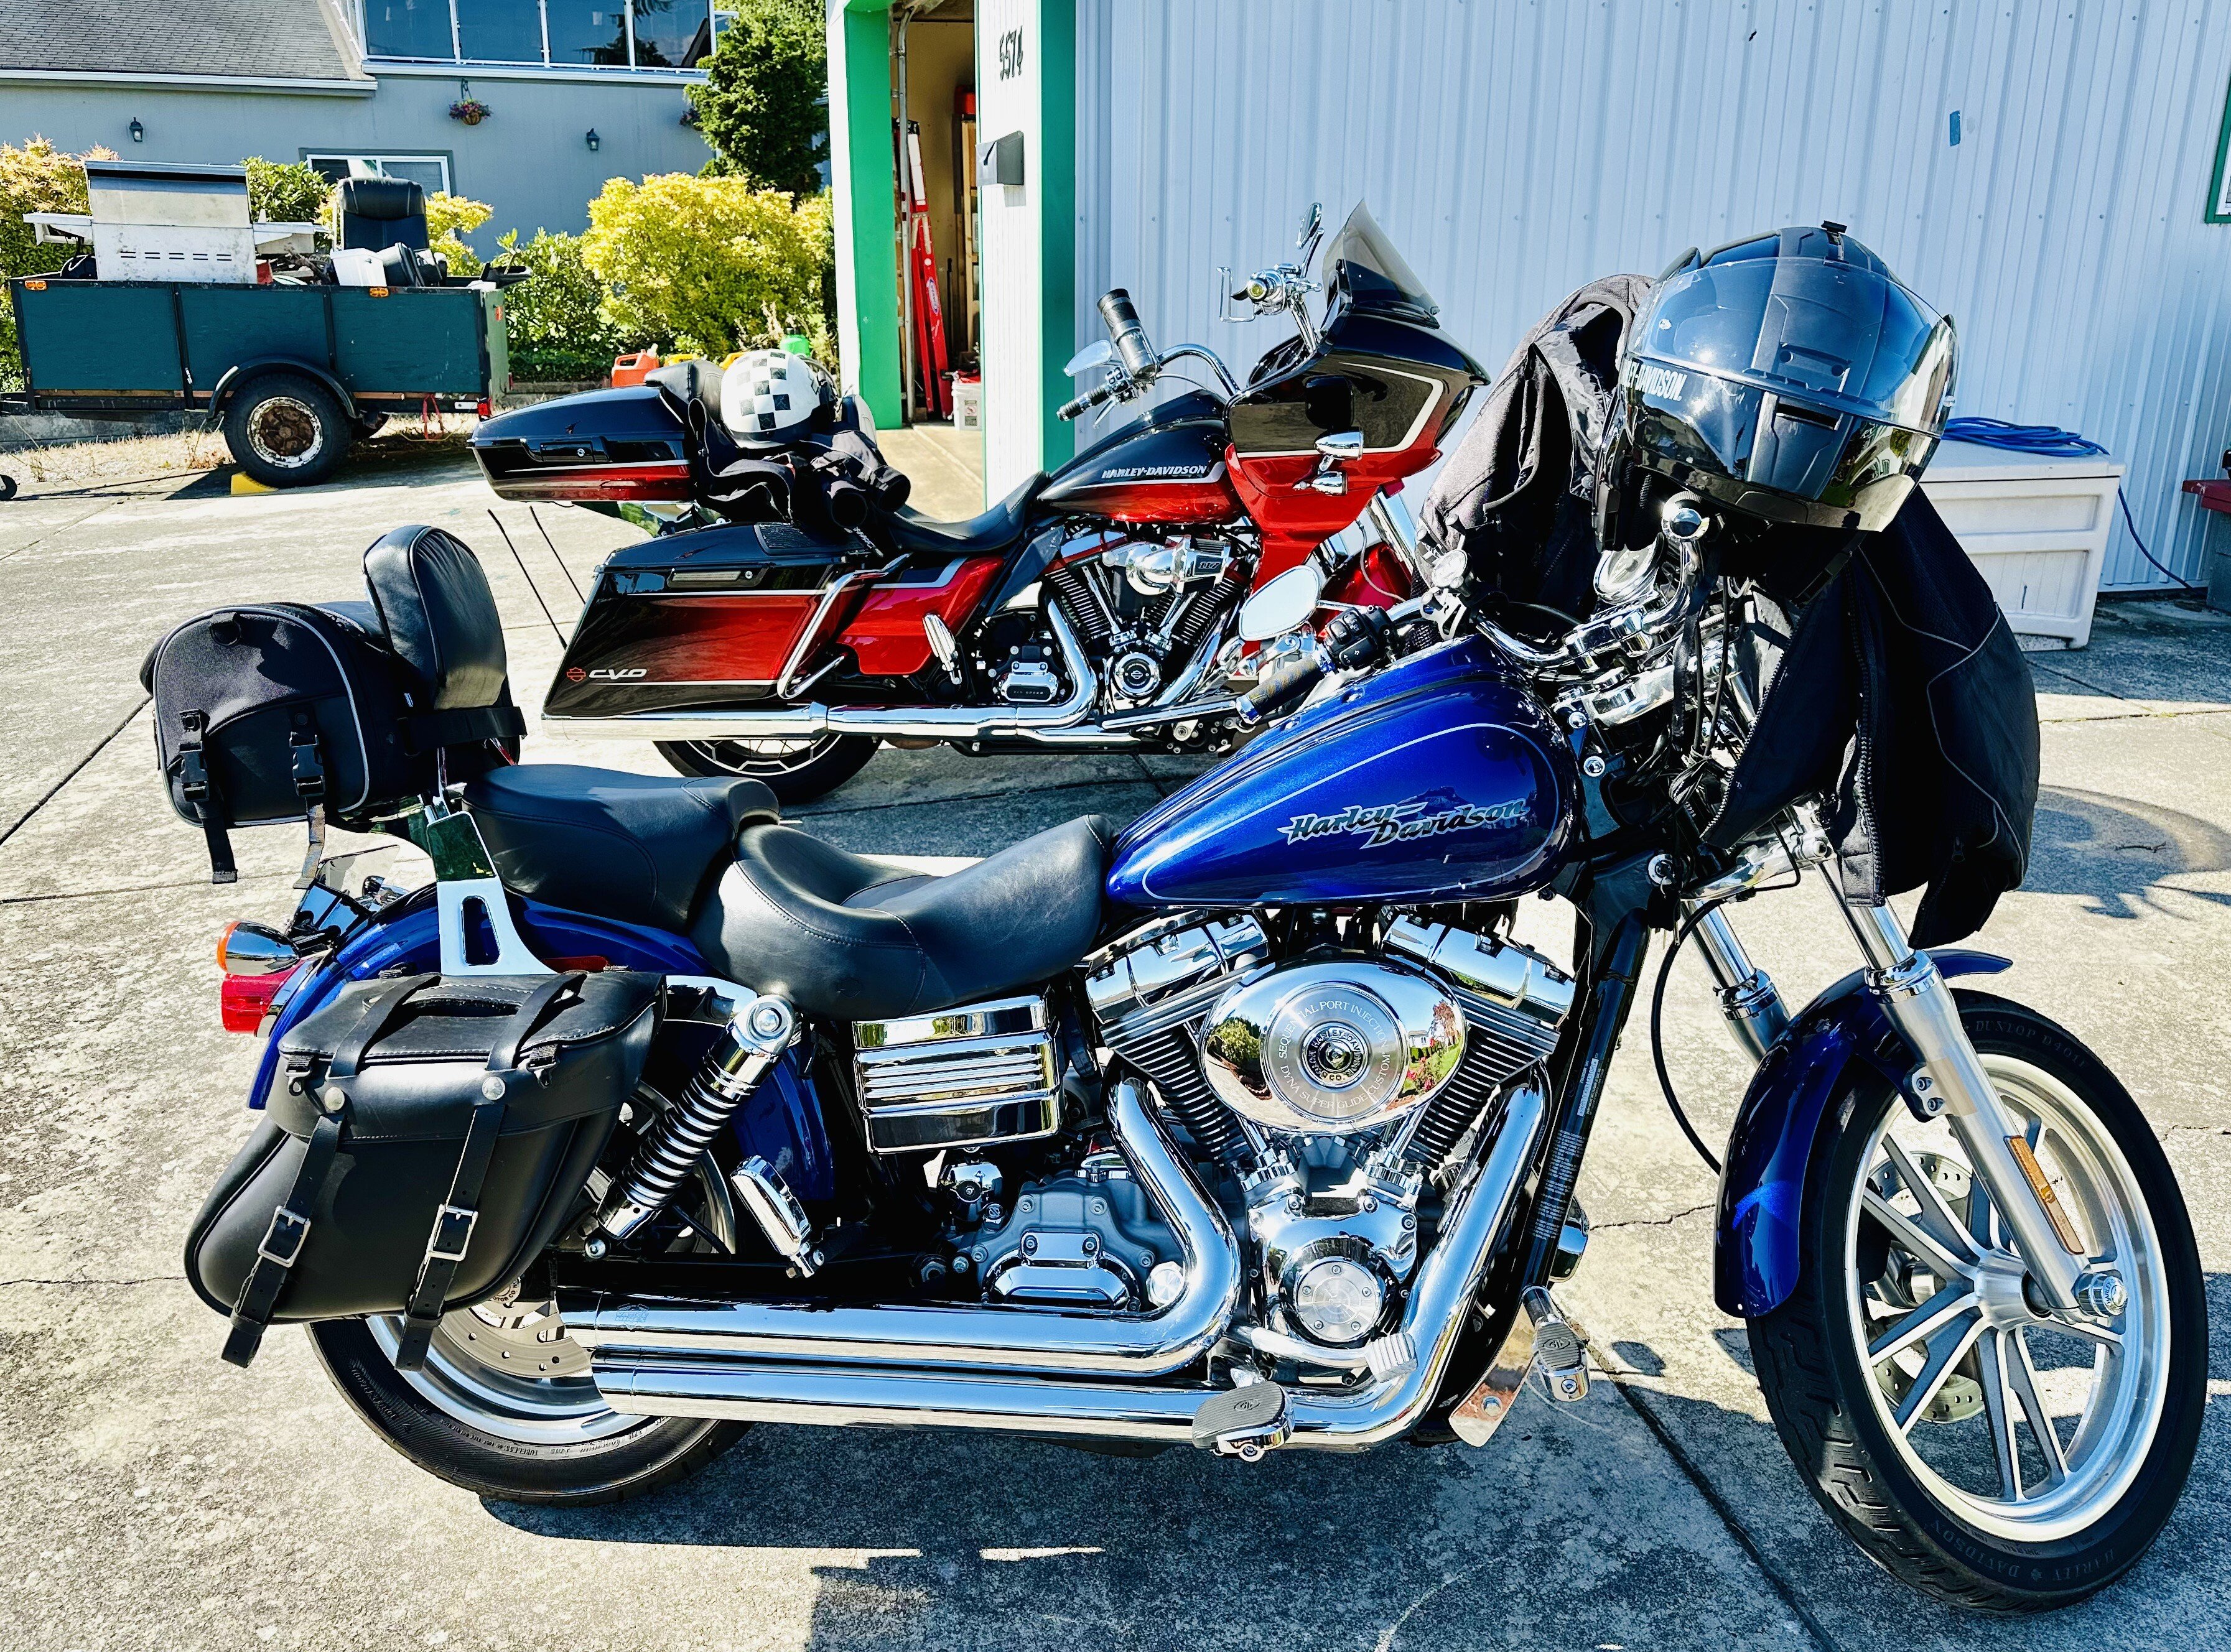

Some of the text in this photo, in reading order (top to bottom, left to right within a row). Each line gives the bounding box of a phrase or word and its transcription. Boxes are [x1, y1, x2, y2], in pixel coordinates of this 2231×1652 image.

[1101, 465, 1207, 479] HARLEY-DAVIDSON
[1198, 561, 1221, 569] 117
[589, 669, 647, 680] CVO
[1279, 1000, 1389, 1059] SEQUENIAL PORT INJECTION
[1280, 1054, 1390, 1110] DYNA SUPER GLIDE CUSTOM
